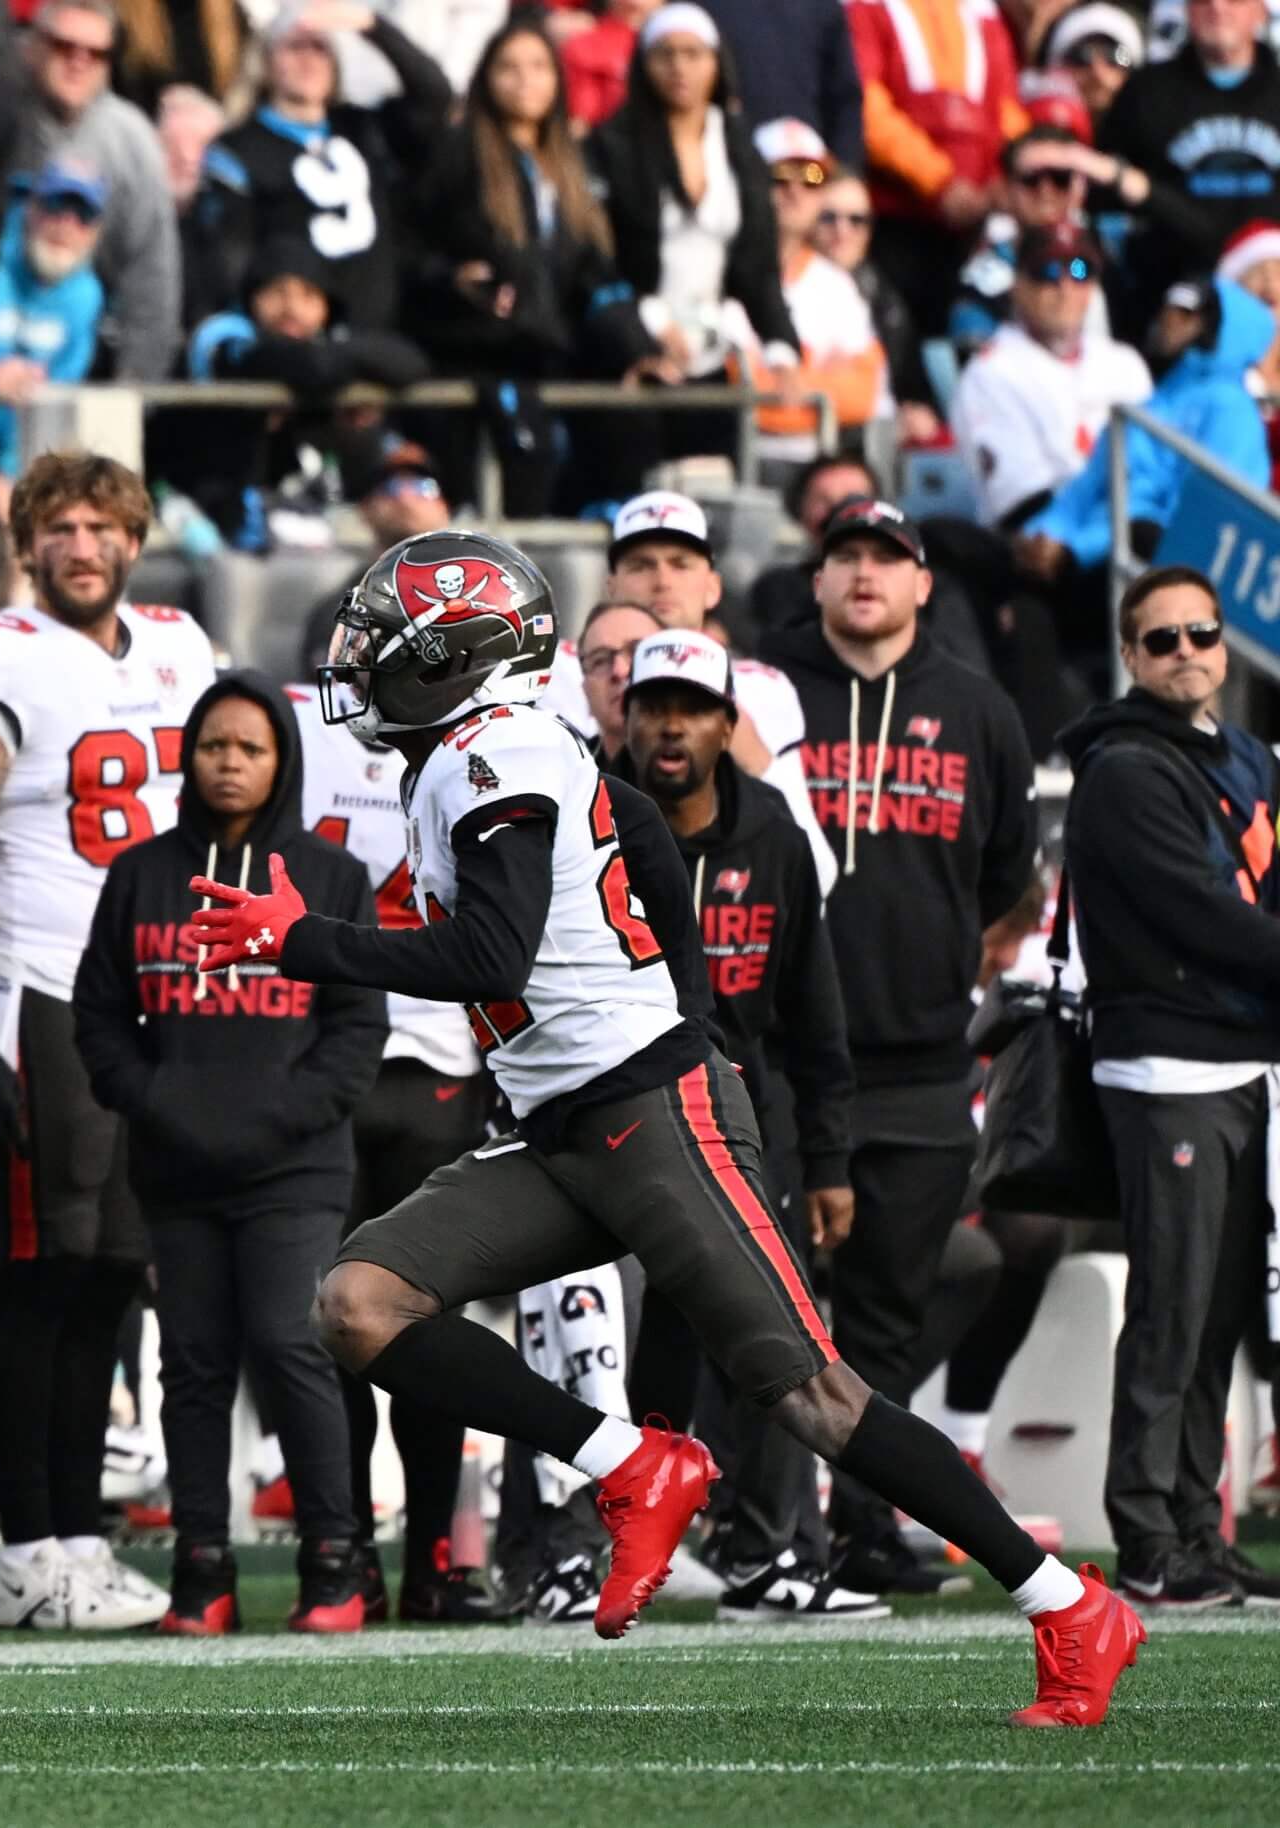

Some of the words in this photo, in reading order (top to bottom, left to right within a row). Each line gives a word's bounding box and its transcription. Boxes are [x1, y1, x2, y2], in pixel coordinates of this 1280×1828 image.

[293, 135, 377, 257] 9
[800, 739, 968, 793] NSPIRE
[808, 790, 963, 842] HANGE
